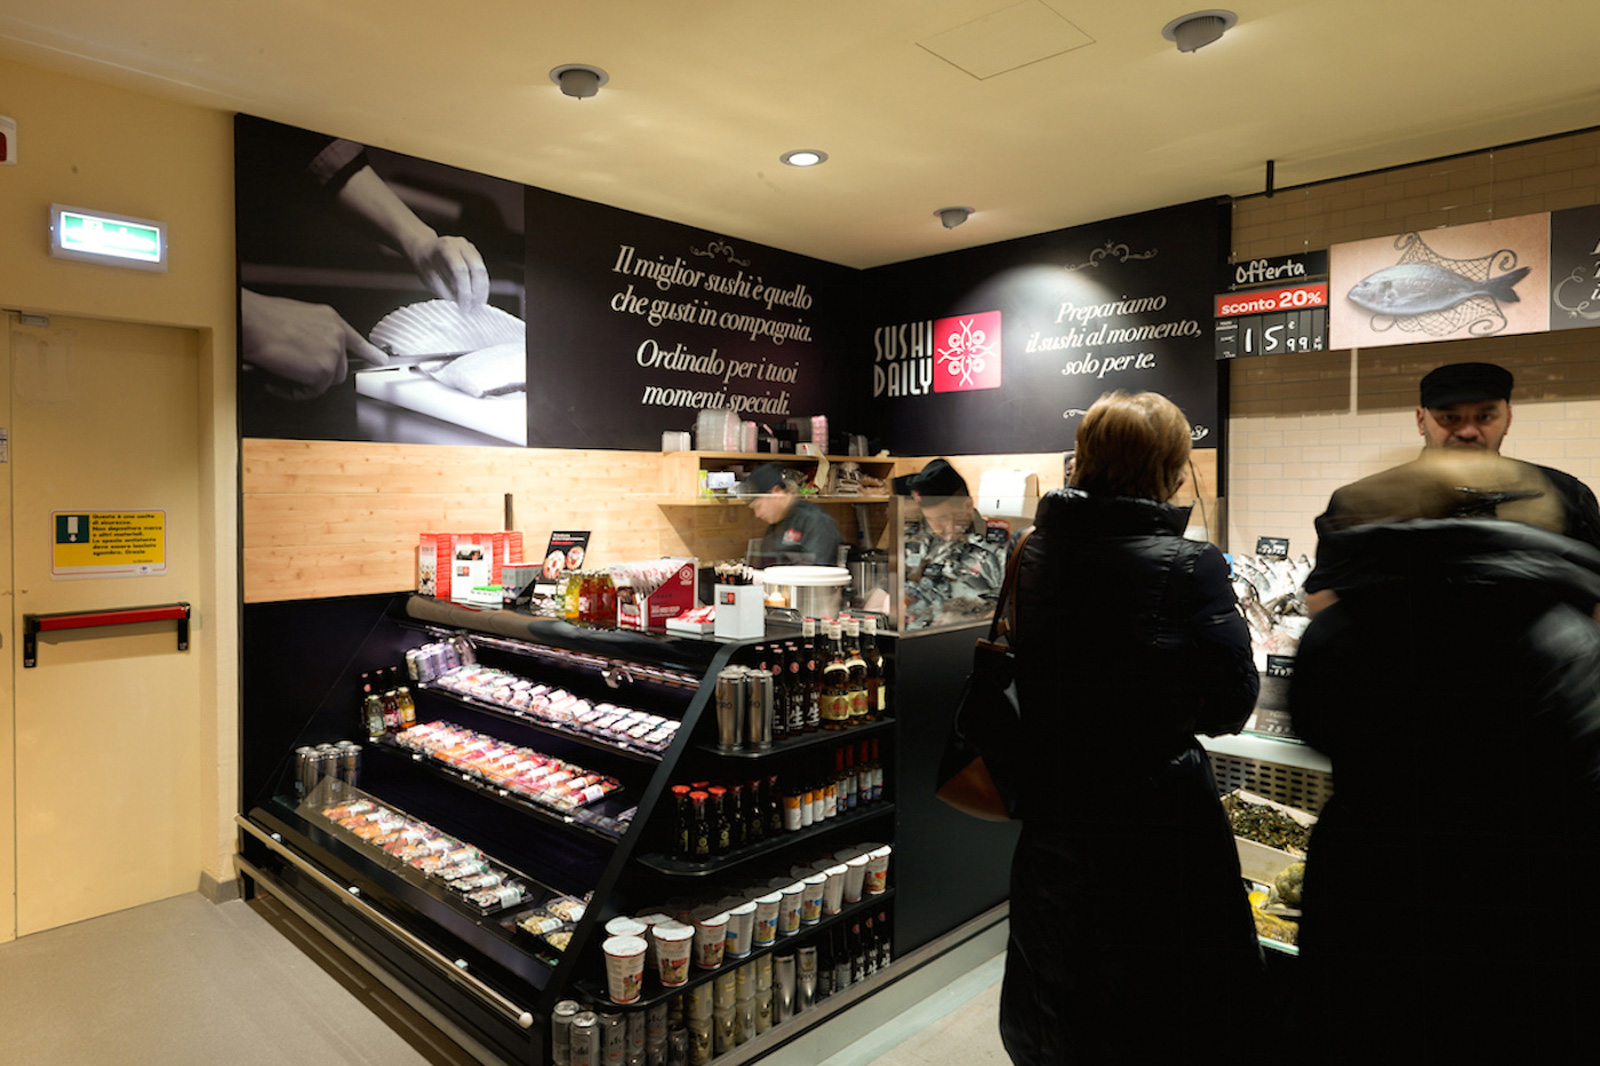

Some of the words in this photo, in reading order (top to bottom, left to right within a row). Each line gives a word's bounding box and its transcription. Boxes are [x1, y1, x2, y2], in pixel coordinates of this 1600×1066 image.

[612, 244, 635, 275] Il
[634, 255, 705, 291] miglior
[704, 271, 754, 299] sushi
[752, 276, 763, 301] è
[763, 284, 813, 311] quello
[1235, 259, 1305, 283] Offerta
[610, 285, 649, 315] che
[647, 297, 700, 327] gusti
[698, 300, 717, 327] in
[719, 311, 813, 346] compagnia.
[1055, 294, 1167, 324] Prepariamo
[1221, 299, 1276, 314] sconto
[1279, 289, 1323, 308] 20%
[873, 320, 934, 362] SUSHI
[1025, 335, 1040, 354] il
[1037, 330, 1086, 352] sushi
[1085, 325, 1107, 347] al
[1109, 319, 1203, 345] momento,
[1244, 324, 1285, 353] 15
[636, 339, 726, 376] Ordinalo
[723, 359, 757, 385] per
[756, 357, 767, 380] i
[765, 362, 800, 385] tuoi
[872, 356, 934, 398] DAILY
[1061, 352, 1101, 376] solo
[1096, 357, 1134, 379] per
[1131, 352, 1157, 370] te.
[641, 384, 727, 411] momenti
[726, 391, 791, 416] speciali.
